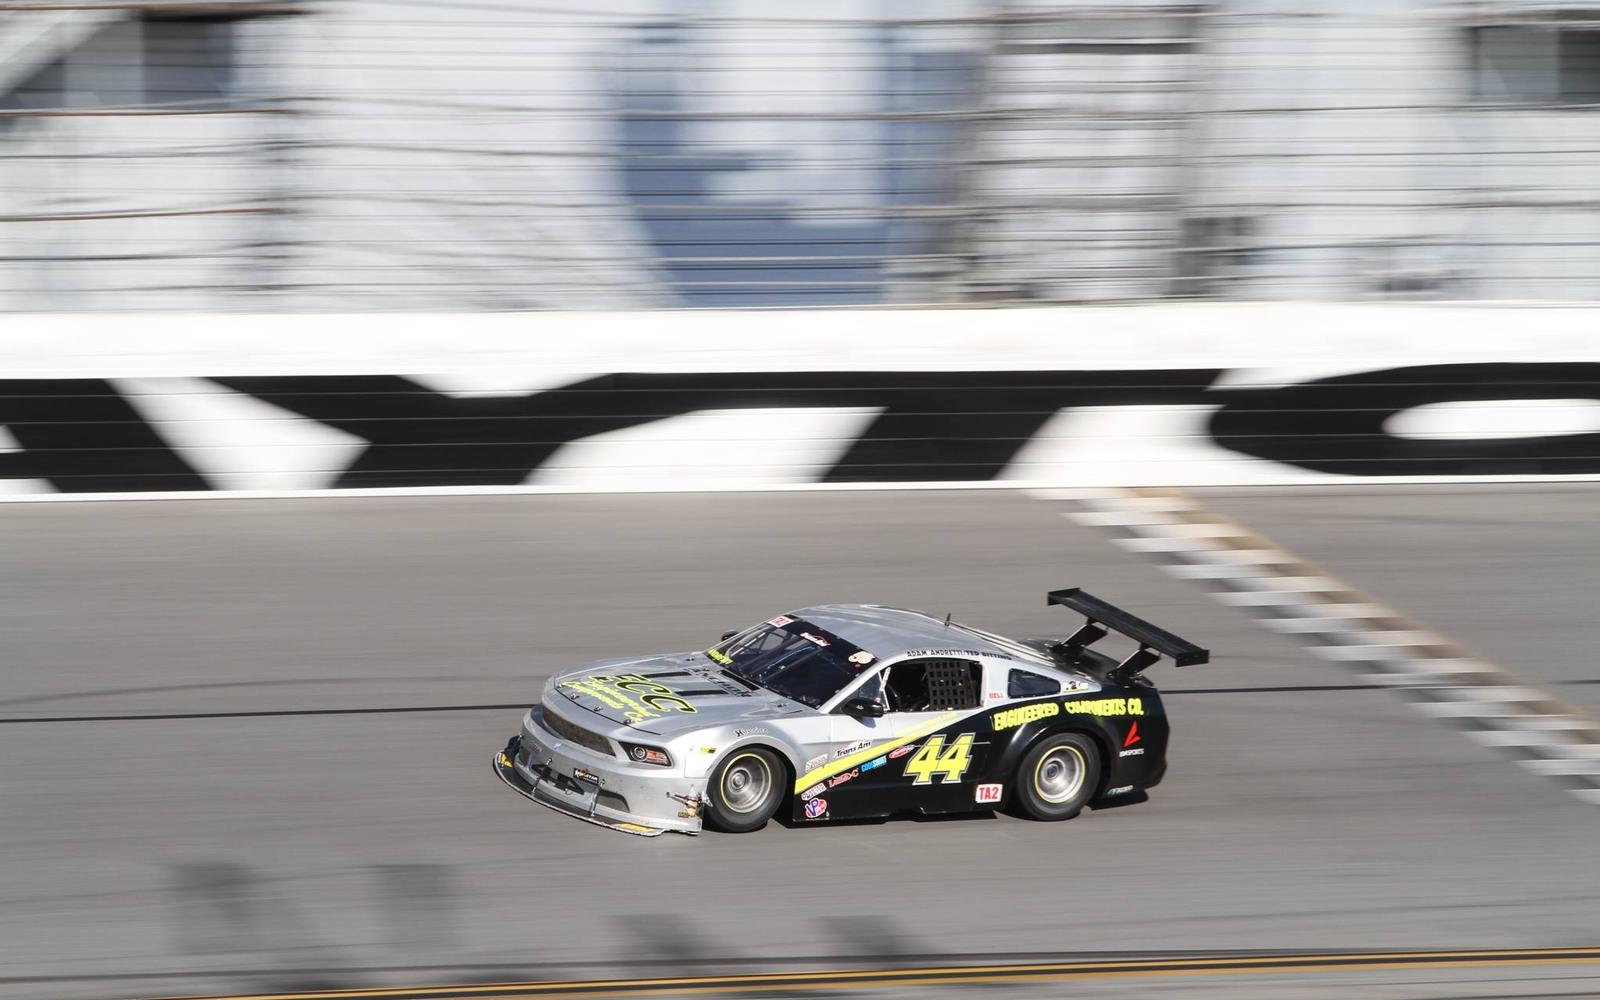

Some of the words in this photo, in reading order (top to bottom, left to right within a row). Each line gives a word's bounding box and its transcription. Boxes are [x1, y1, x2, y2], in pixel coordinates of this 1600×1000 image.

[994, 702, 1059, 731] ENGINEERED
[836, 746, 857, 758] Trans
[857, 741, 872, 751] Am
[903, 732, 975, 786] 44
[978, 786, 1000, 801] TA2
